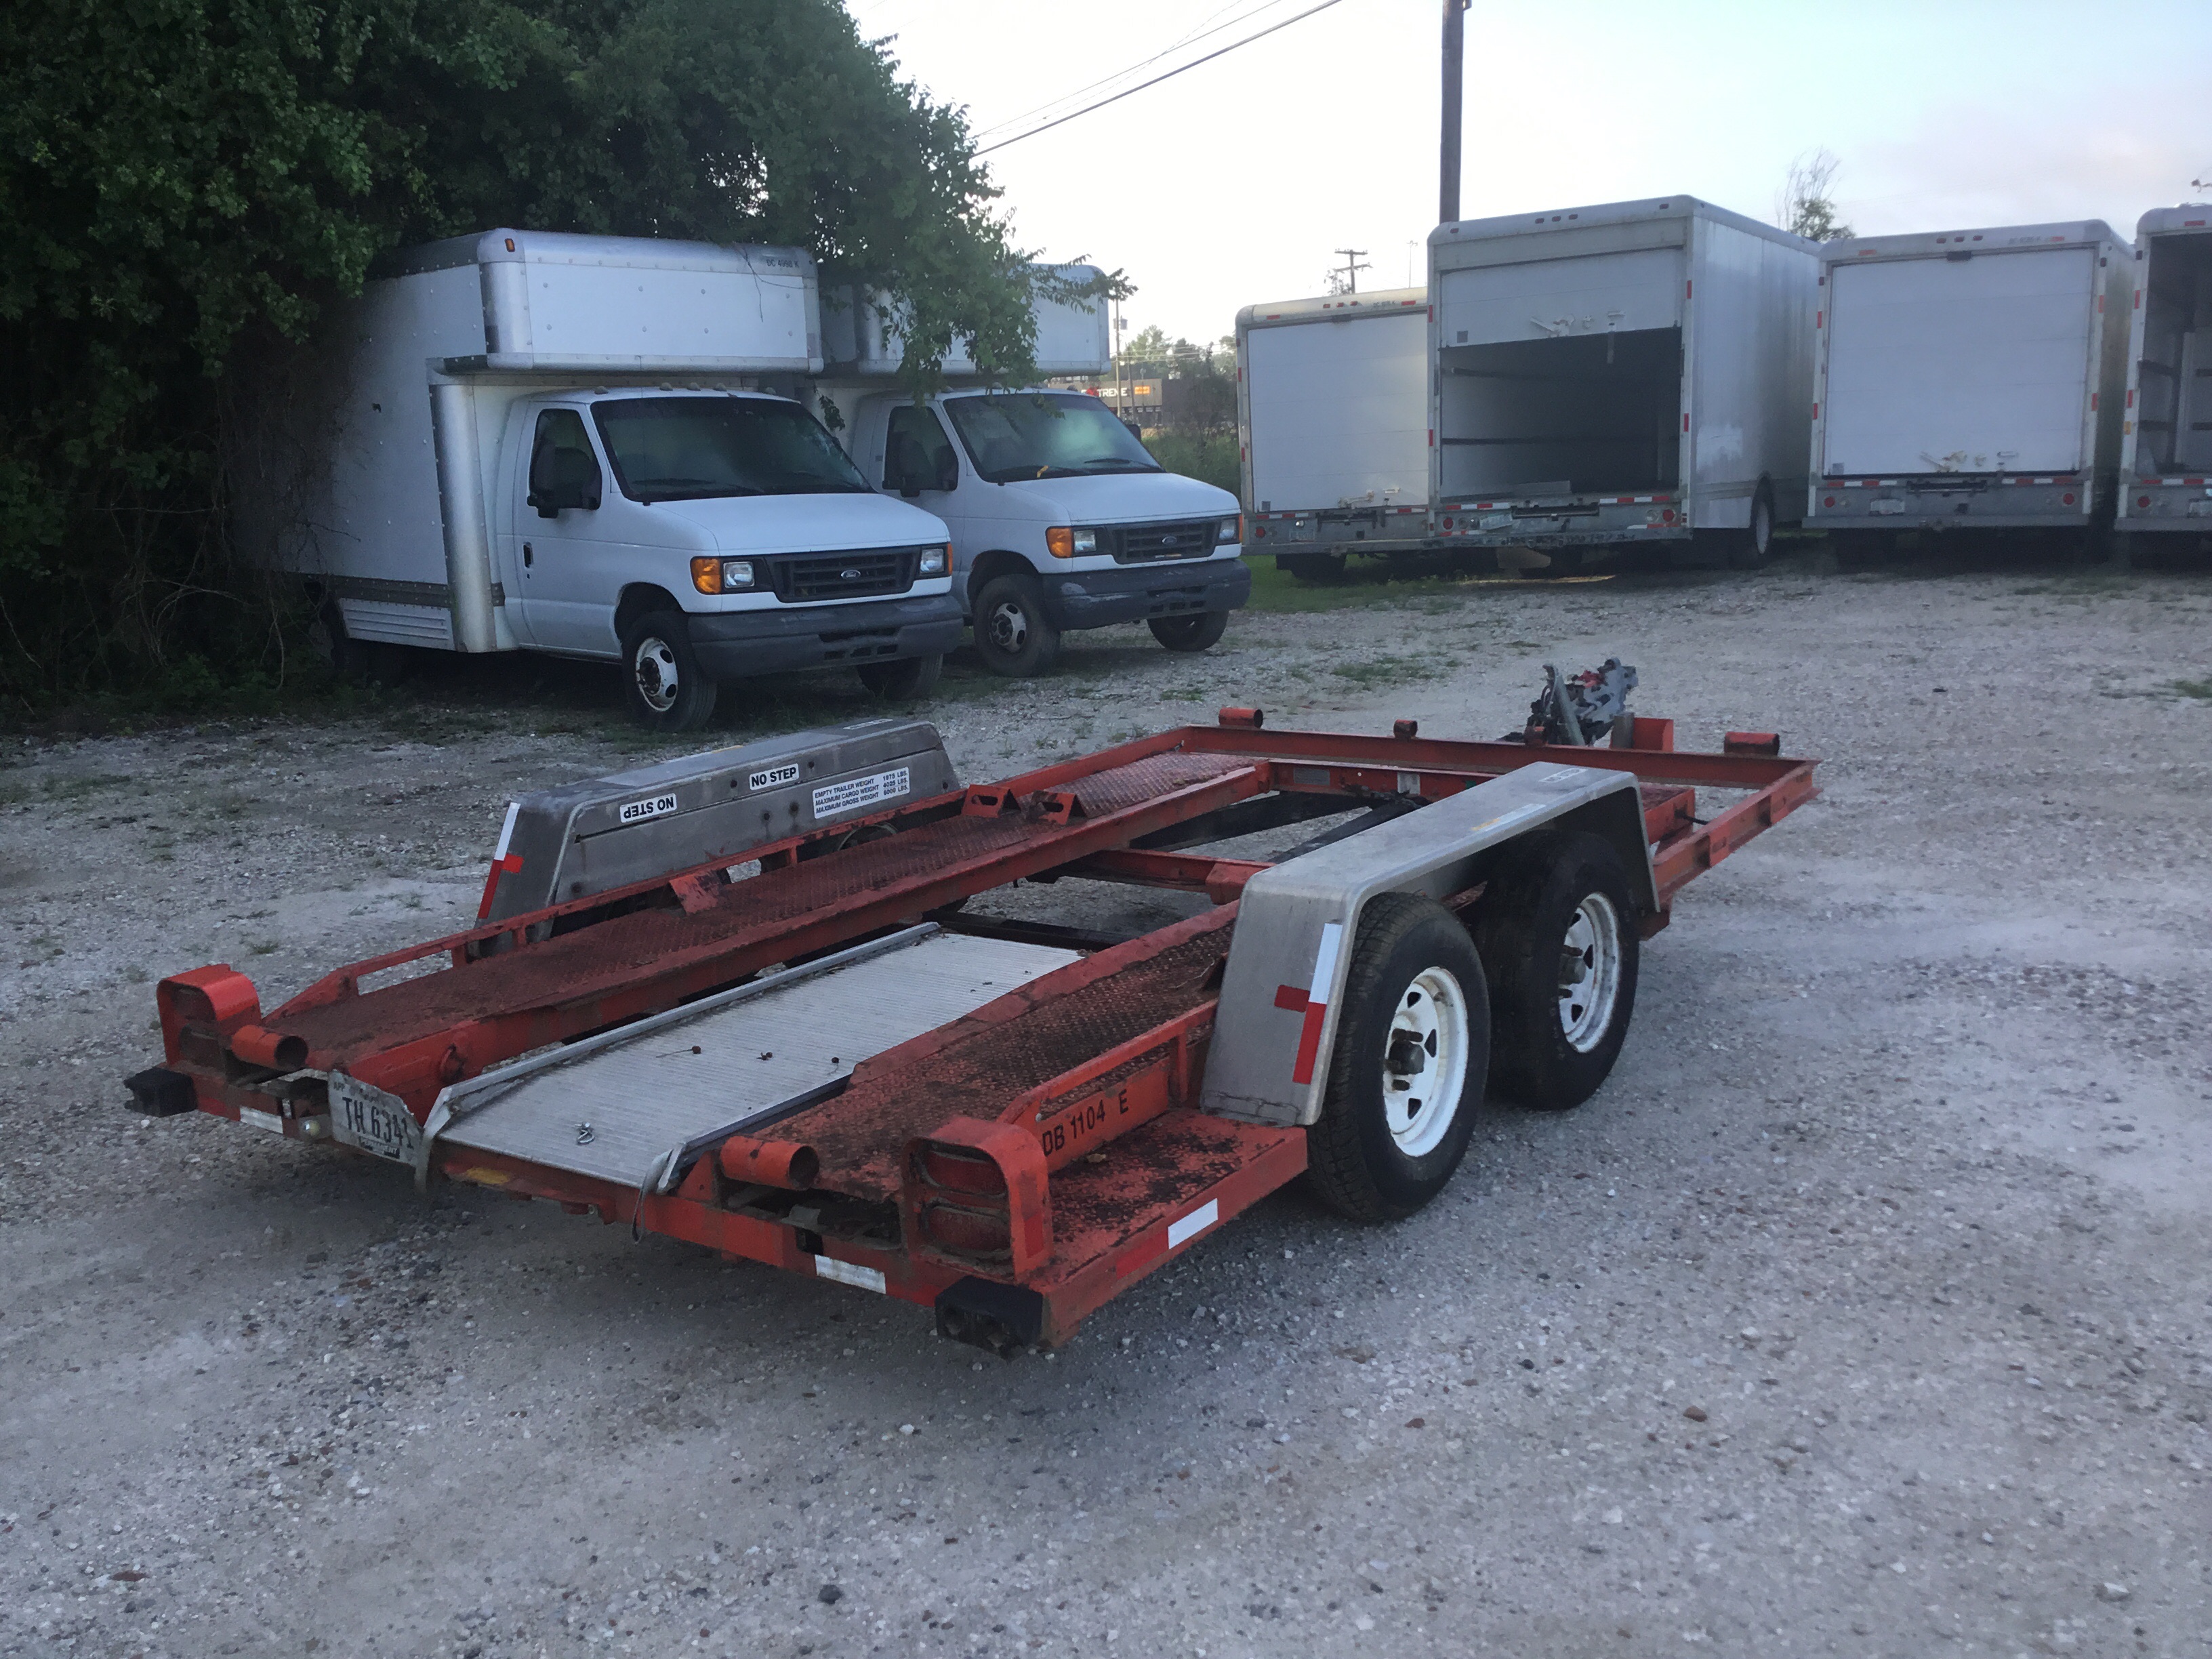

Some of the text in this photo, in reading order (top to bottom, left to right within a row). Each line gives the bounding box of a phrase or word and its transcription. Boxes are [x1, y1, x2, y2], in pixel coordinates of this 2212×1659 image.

[766, 259, 775, 267] DC
[751, 766, 797, 787] NO STEP
[815, 790, 832, 798] EMPTY
[834, 783, 854, 793] TRAILER
[855, 778, 874, 787] WEIGHT
[815, 794, 840, 806] MAXIMUM
[842, 790, 859, 800] CARGO
[860, 785, 880, 794] WEIGHT
[883, 780, 896, 788] 4025
[816, 802, 841, 814] MAXIMUM
[842, 798, 859, 806] GROSS
[860, 792, 879, 802] WEIGHT
[883, 787, 896, 796] 6000
[623, 796, 674, 819] NO STEP
[342, 1097, 414, 1151] TH 6341
[1042, 1088, 1128, 1157] DB 1104 E
